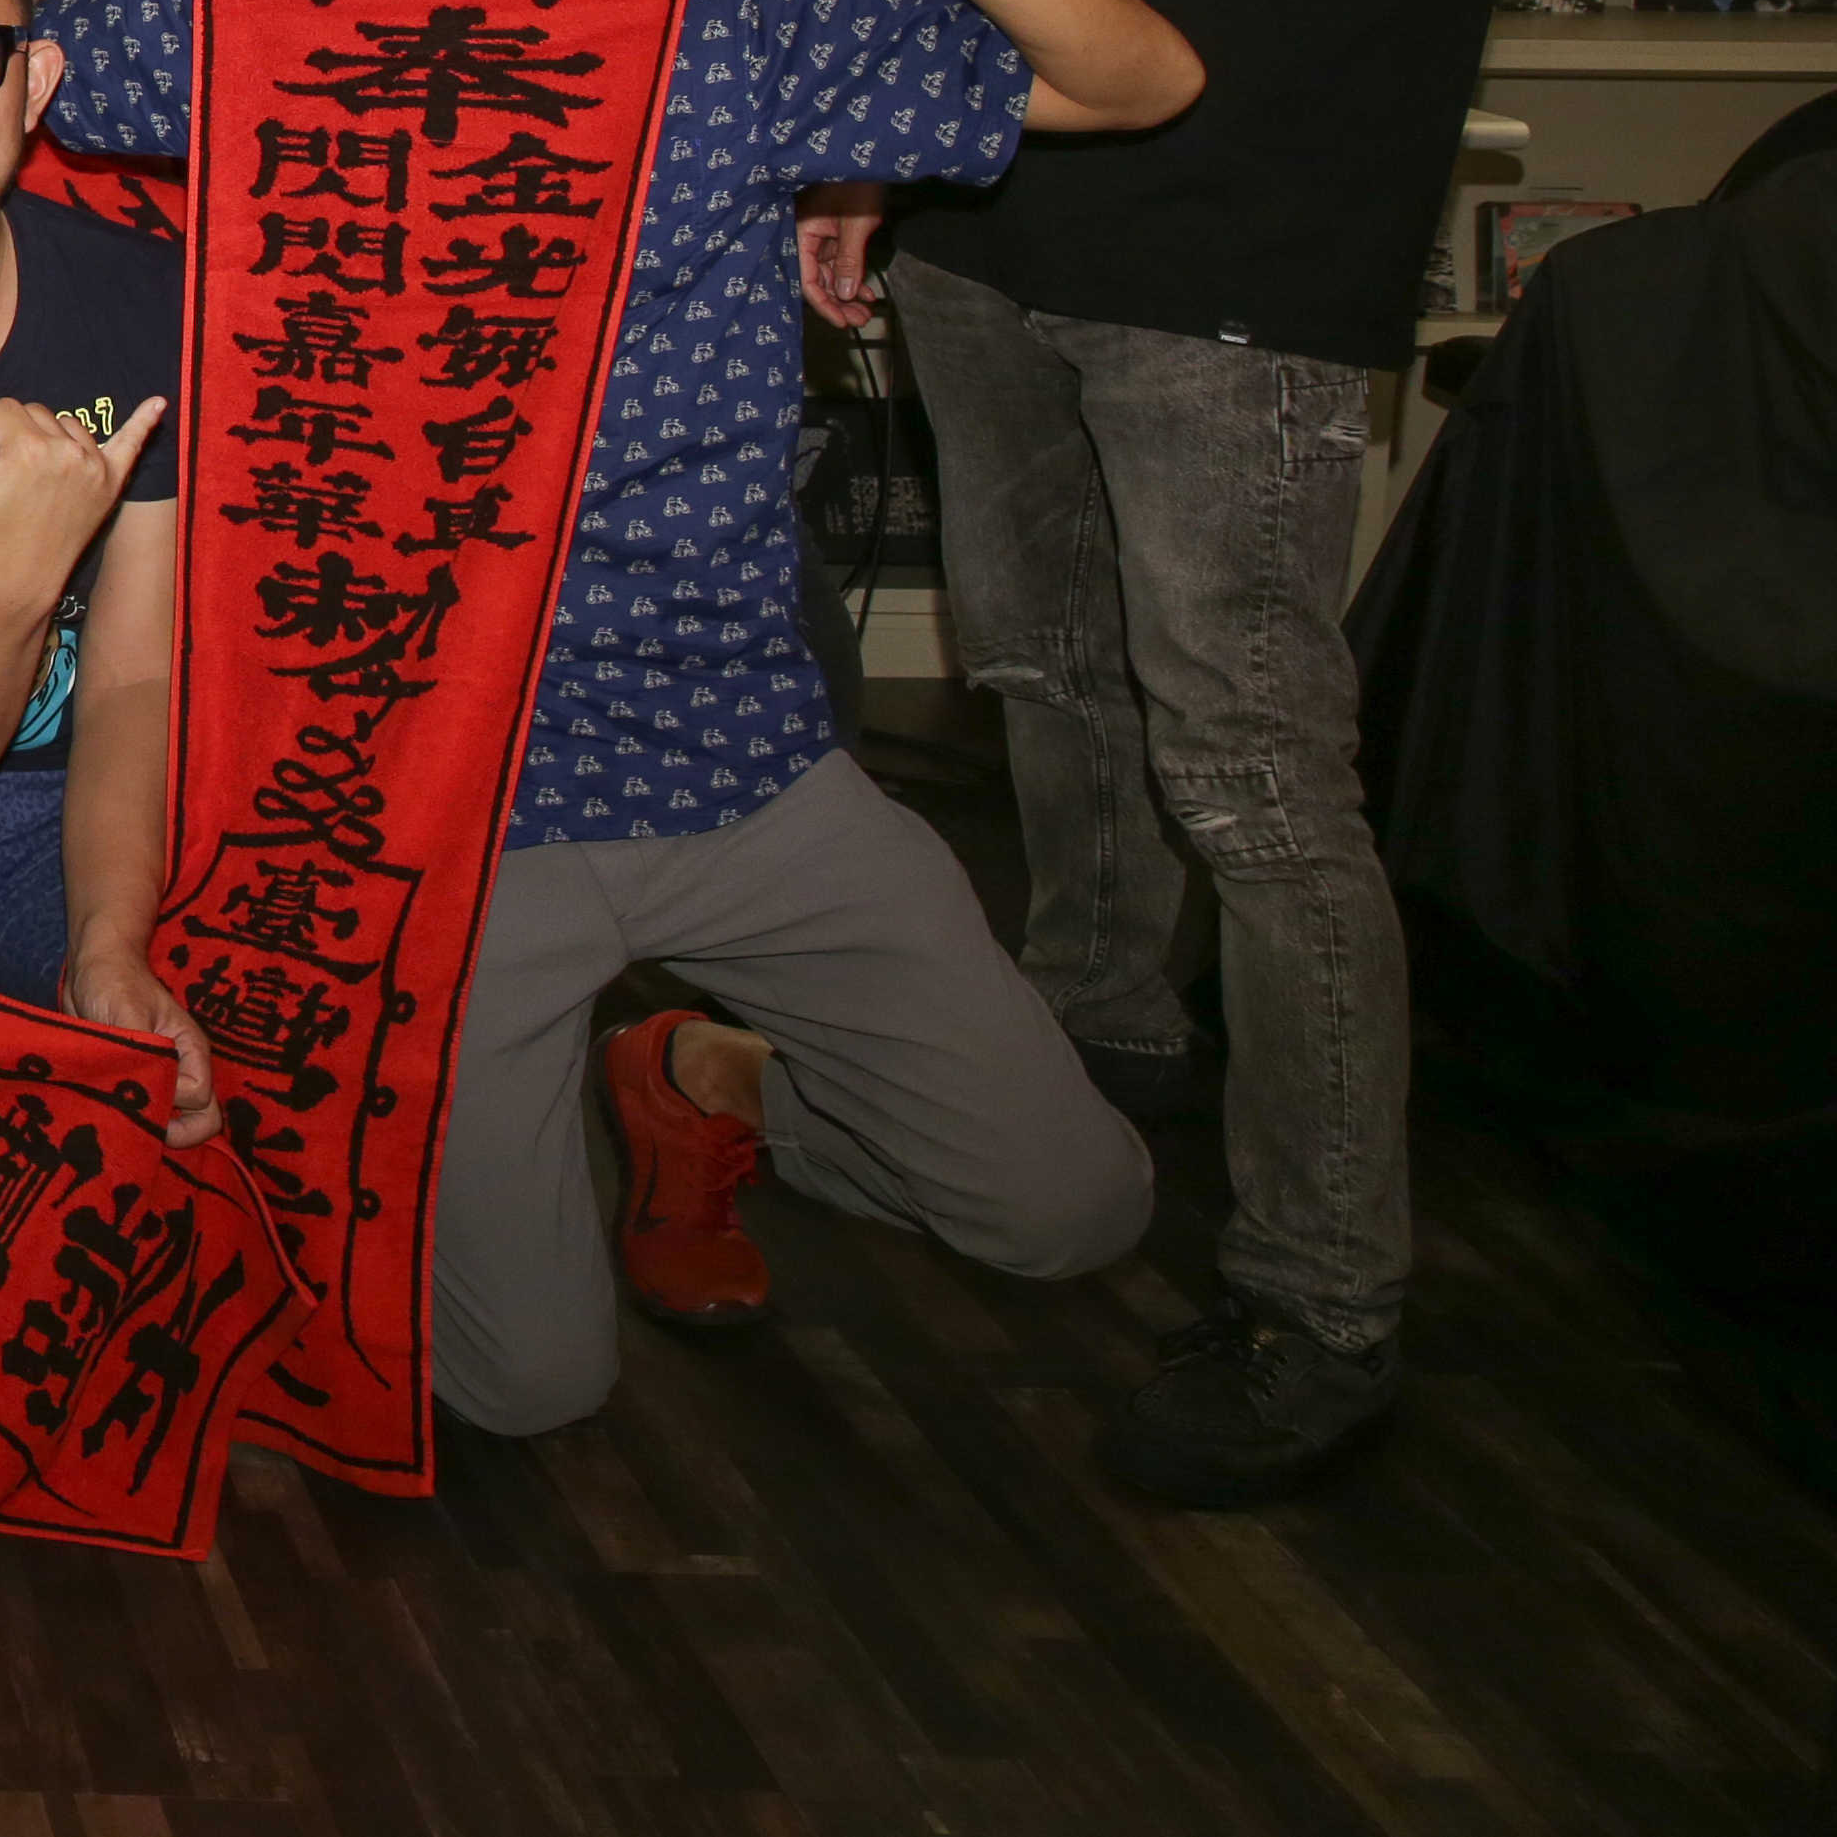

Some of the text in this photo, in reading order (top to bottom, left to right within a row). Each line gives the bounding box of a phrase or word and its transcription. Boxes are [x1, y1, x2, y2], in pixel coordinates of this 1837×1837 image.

[273, 3, 601, 143] 奉
[220, 116, 410, 550] 閃閃嘉年華
[56, 397, 115, 436] 017
